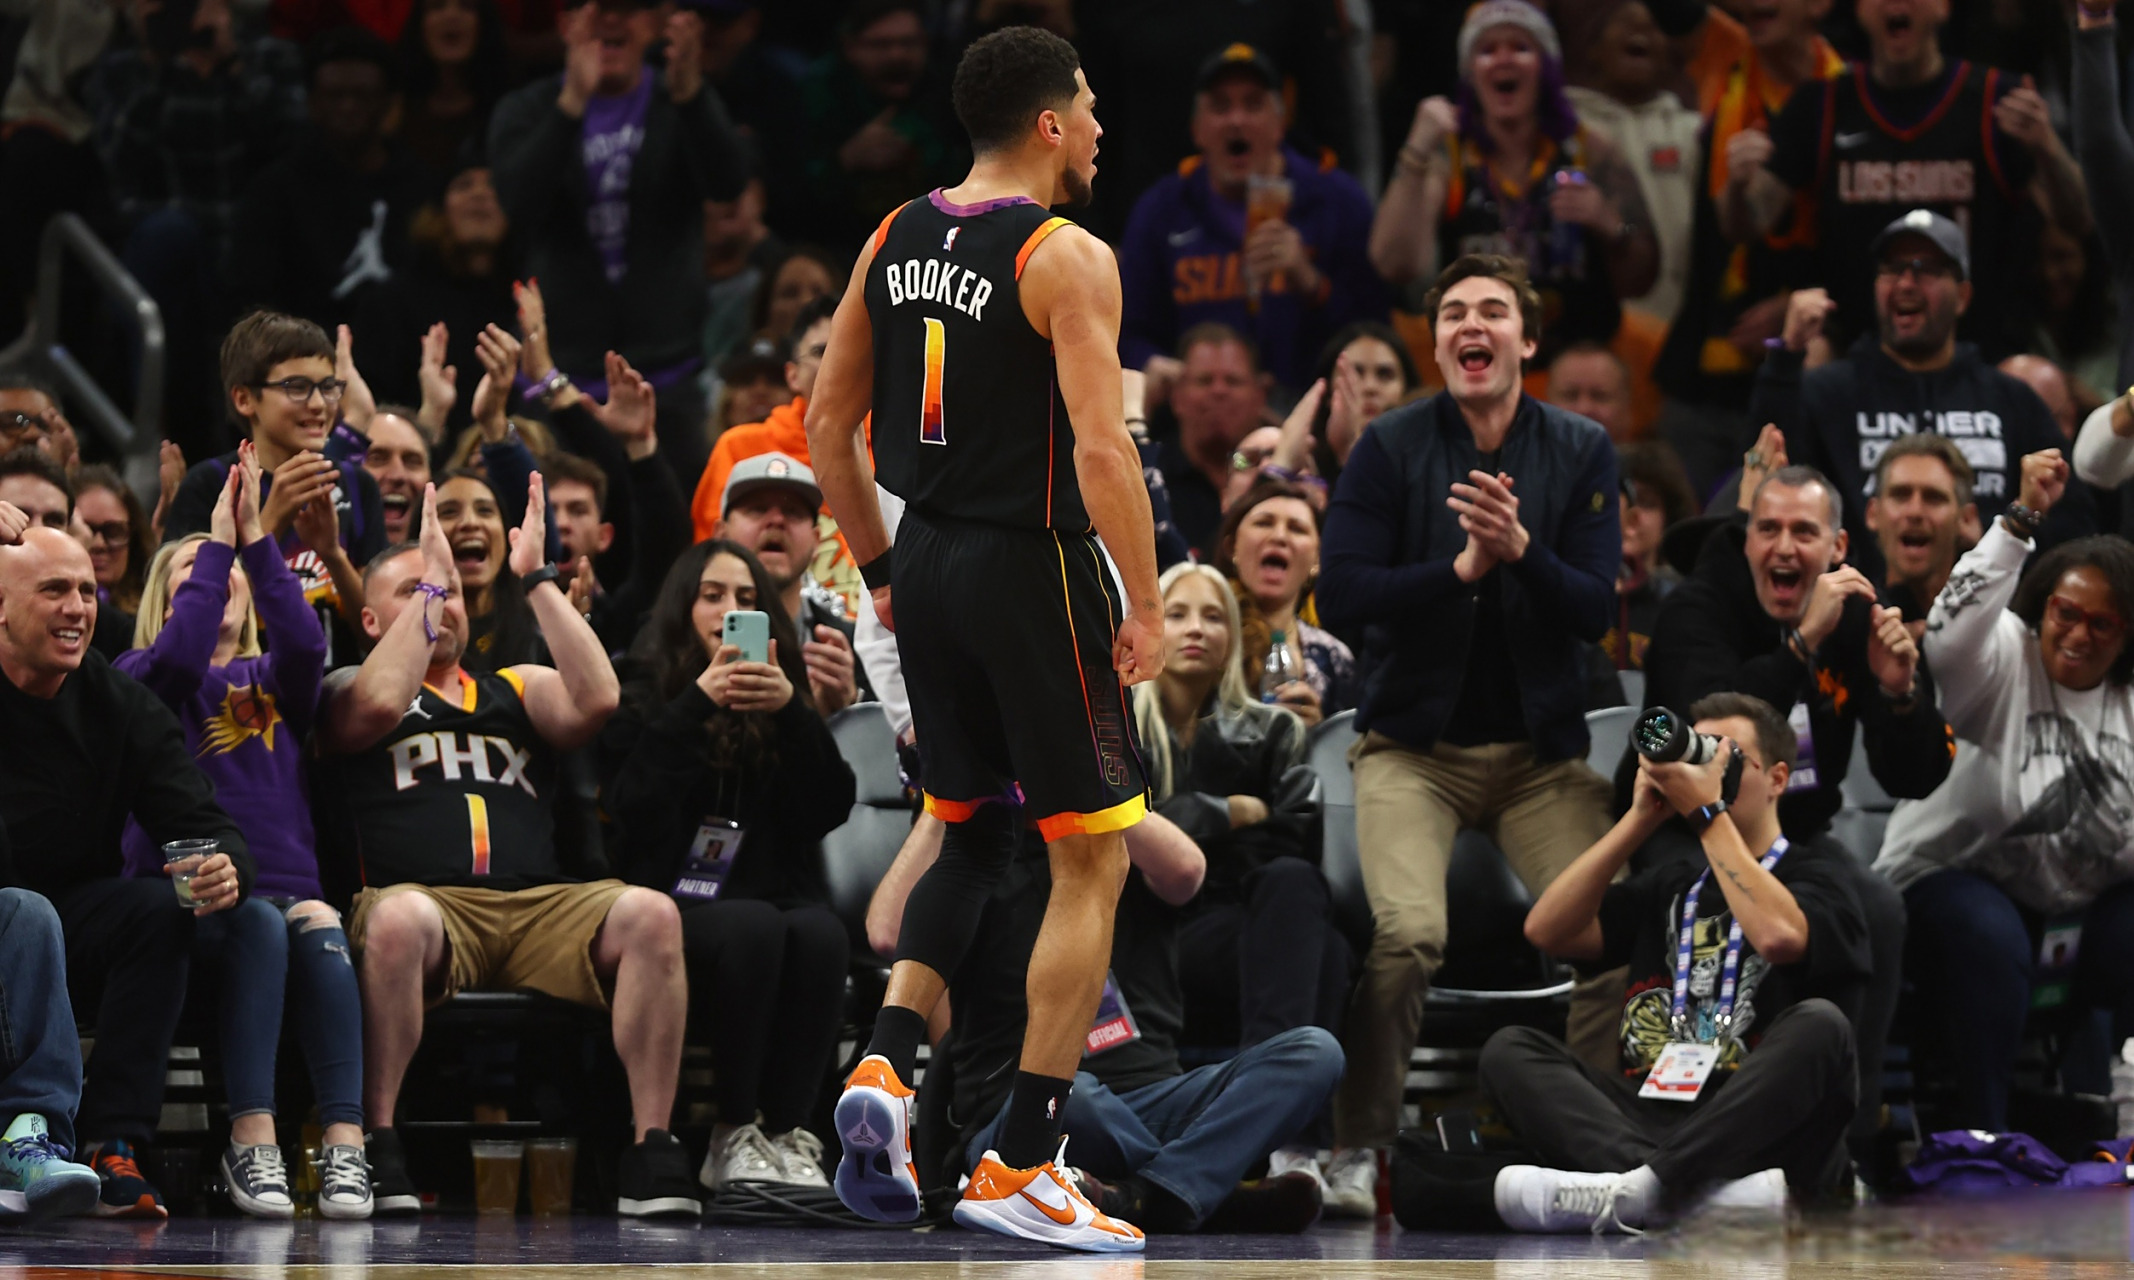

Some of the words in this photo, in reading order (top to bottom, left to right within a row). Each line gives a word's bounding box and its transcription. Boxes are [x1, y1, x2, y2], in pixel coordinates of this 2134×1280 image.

[886, 258, 994, 322] BOOKER
[919, 316, 948, 446] 1
[387, 731, 538, 798] PHX
[463, 792, 492, 877] 1
[675, 877, 719, 897] PARTNER
[1087, 1019, 1130, 1049] OFFICIAL
